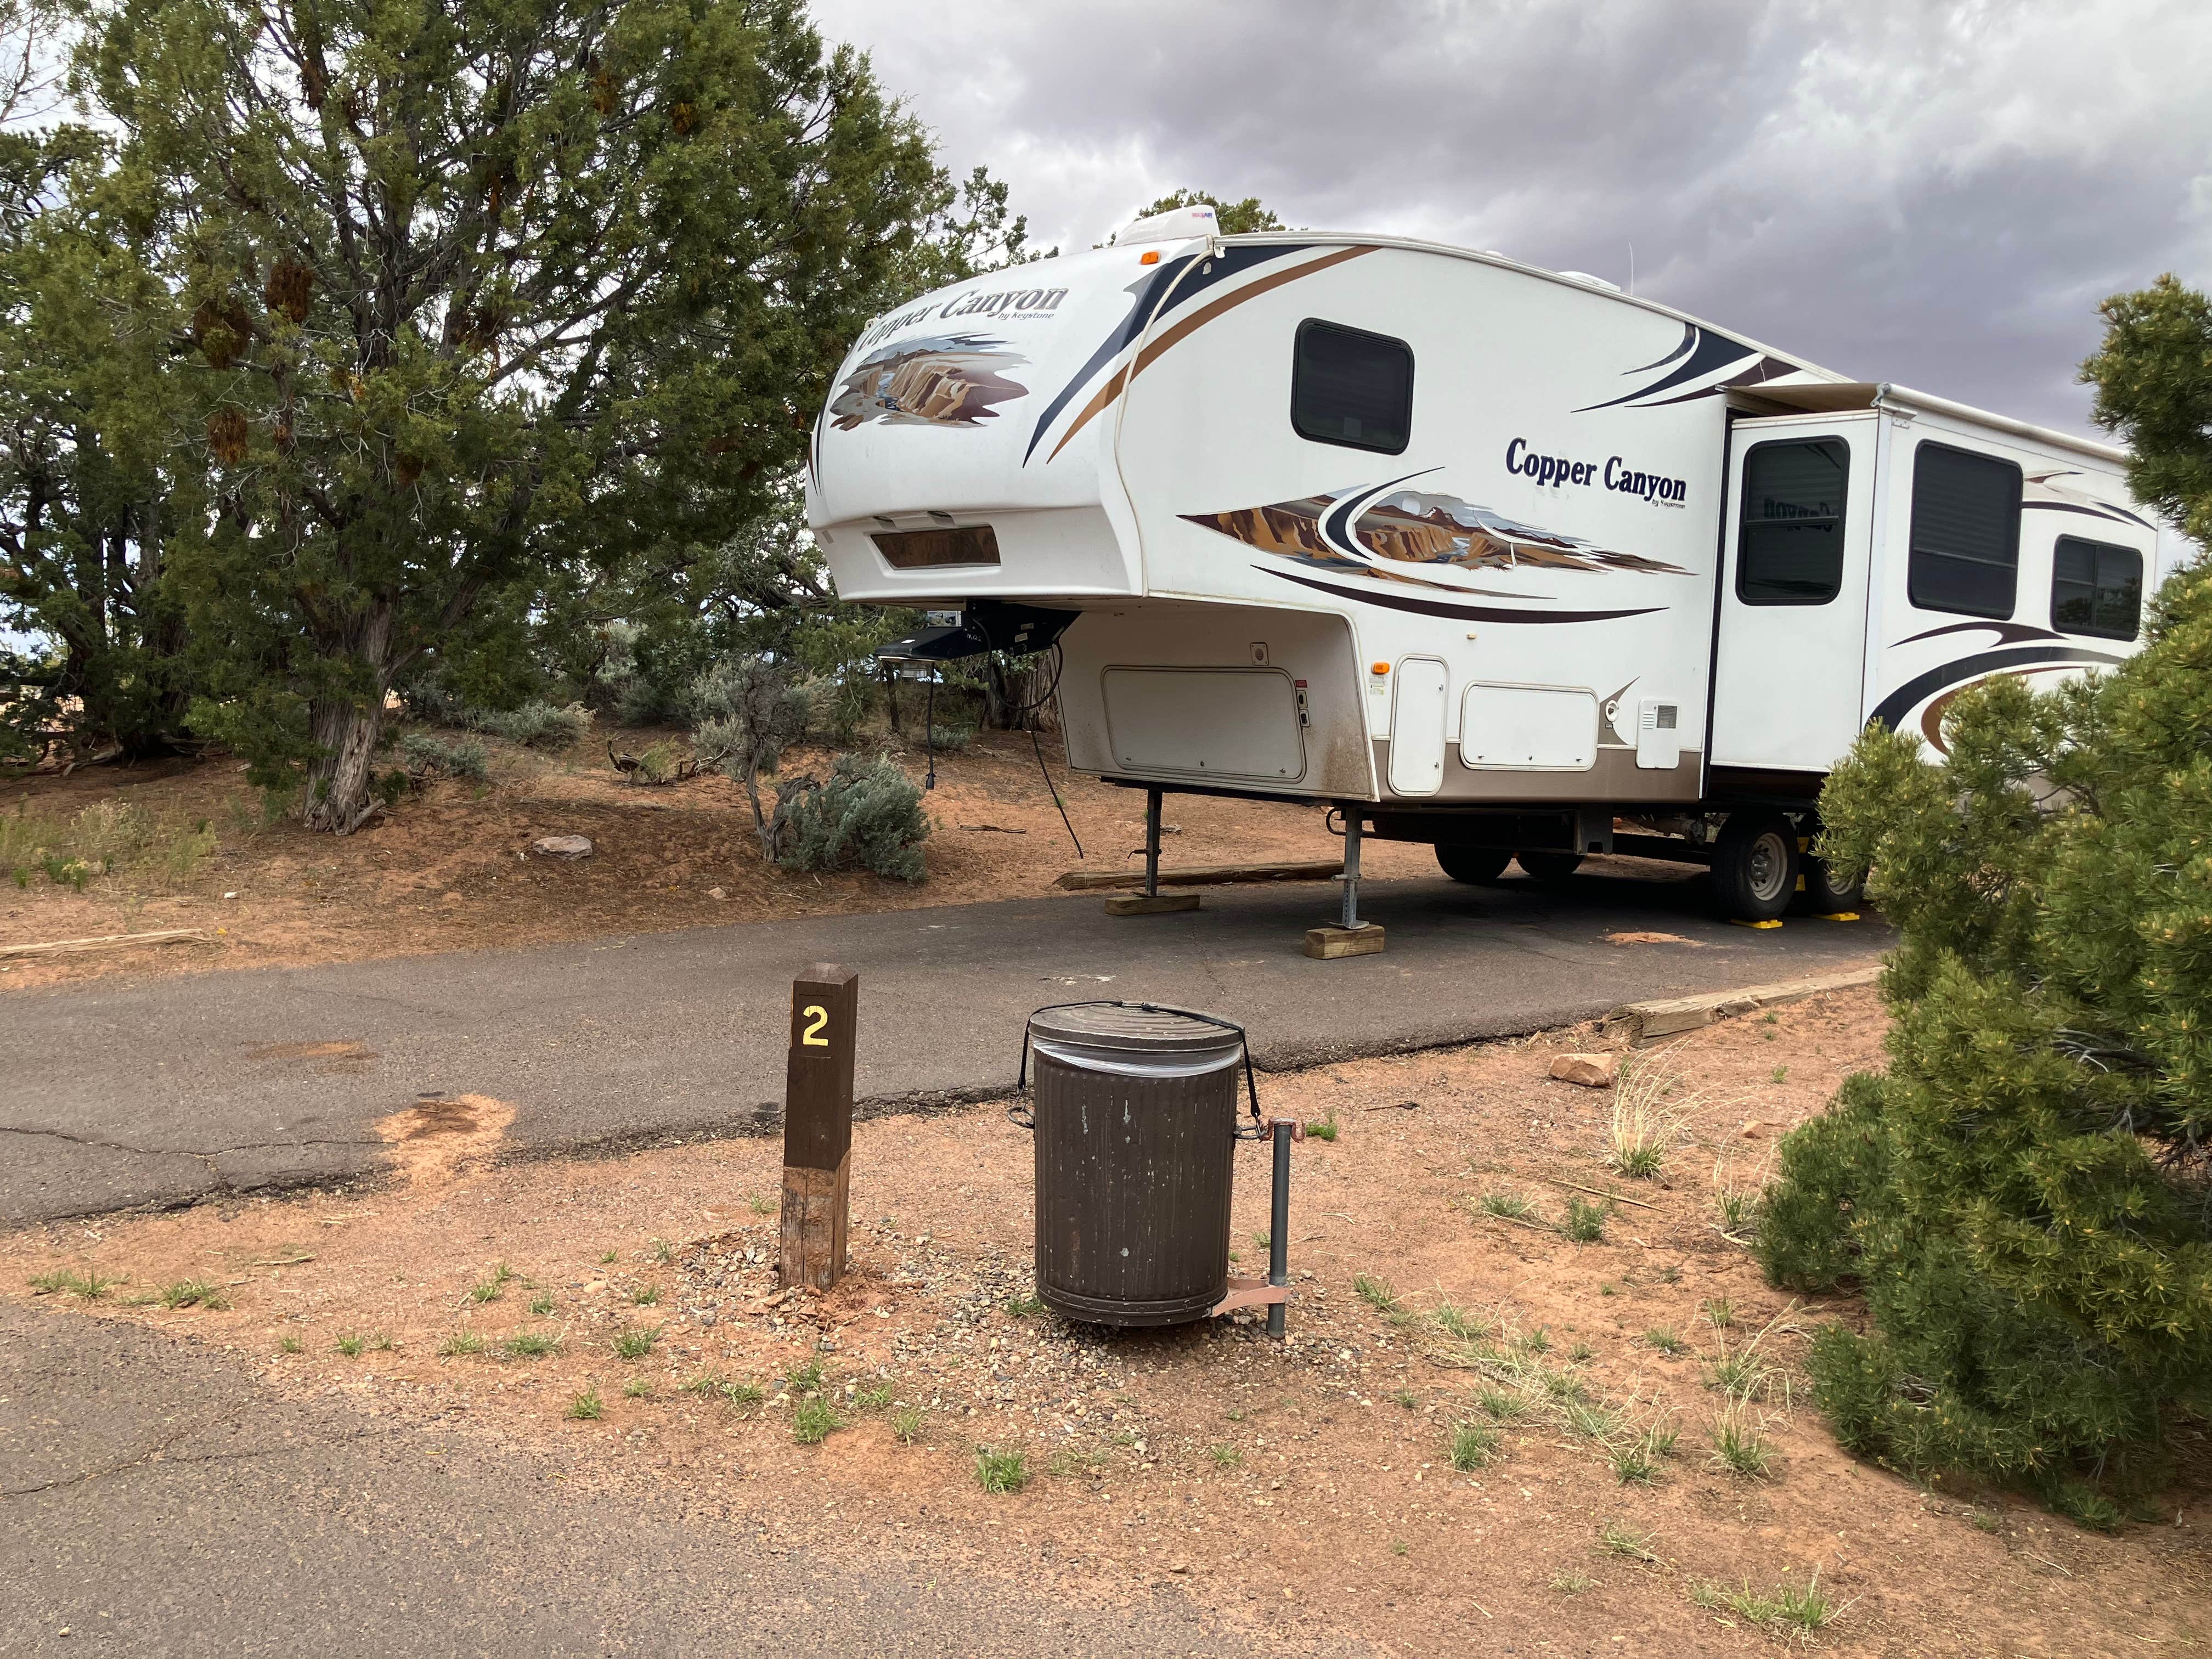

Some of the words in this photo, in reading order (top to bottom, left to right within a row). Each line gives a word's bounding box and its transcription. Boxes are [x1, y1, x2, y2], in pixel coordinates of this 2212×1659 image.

[940, 288, 1069, 319] Canyon
[1506, 437, 1598, 488] Copper
[1604, 455, 1686, 501] Canyon
[803, 1005, 828, 1046] 2
